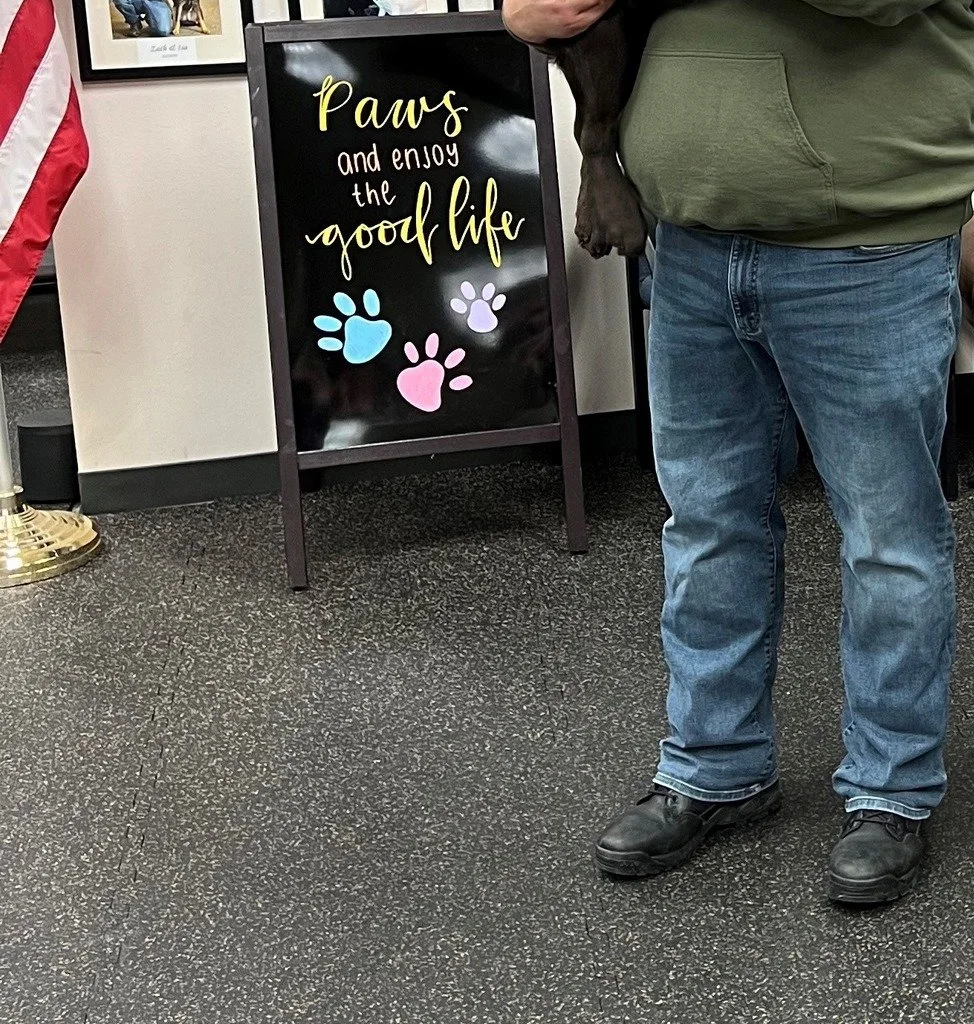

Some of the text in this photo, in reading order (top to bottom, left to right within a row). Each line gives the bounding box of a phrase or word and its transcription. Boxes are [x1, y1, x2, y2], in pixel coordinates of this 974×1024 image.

[313, 75, 469, 138] Paws
[338, 142, 460, 176] and enjoy
[352, 180, 397, 208] the
[305, 175, 526, 281] good life
